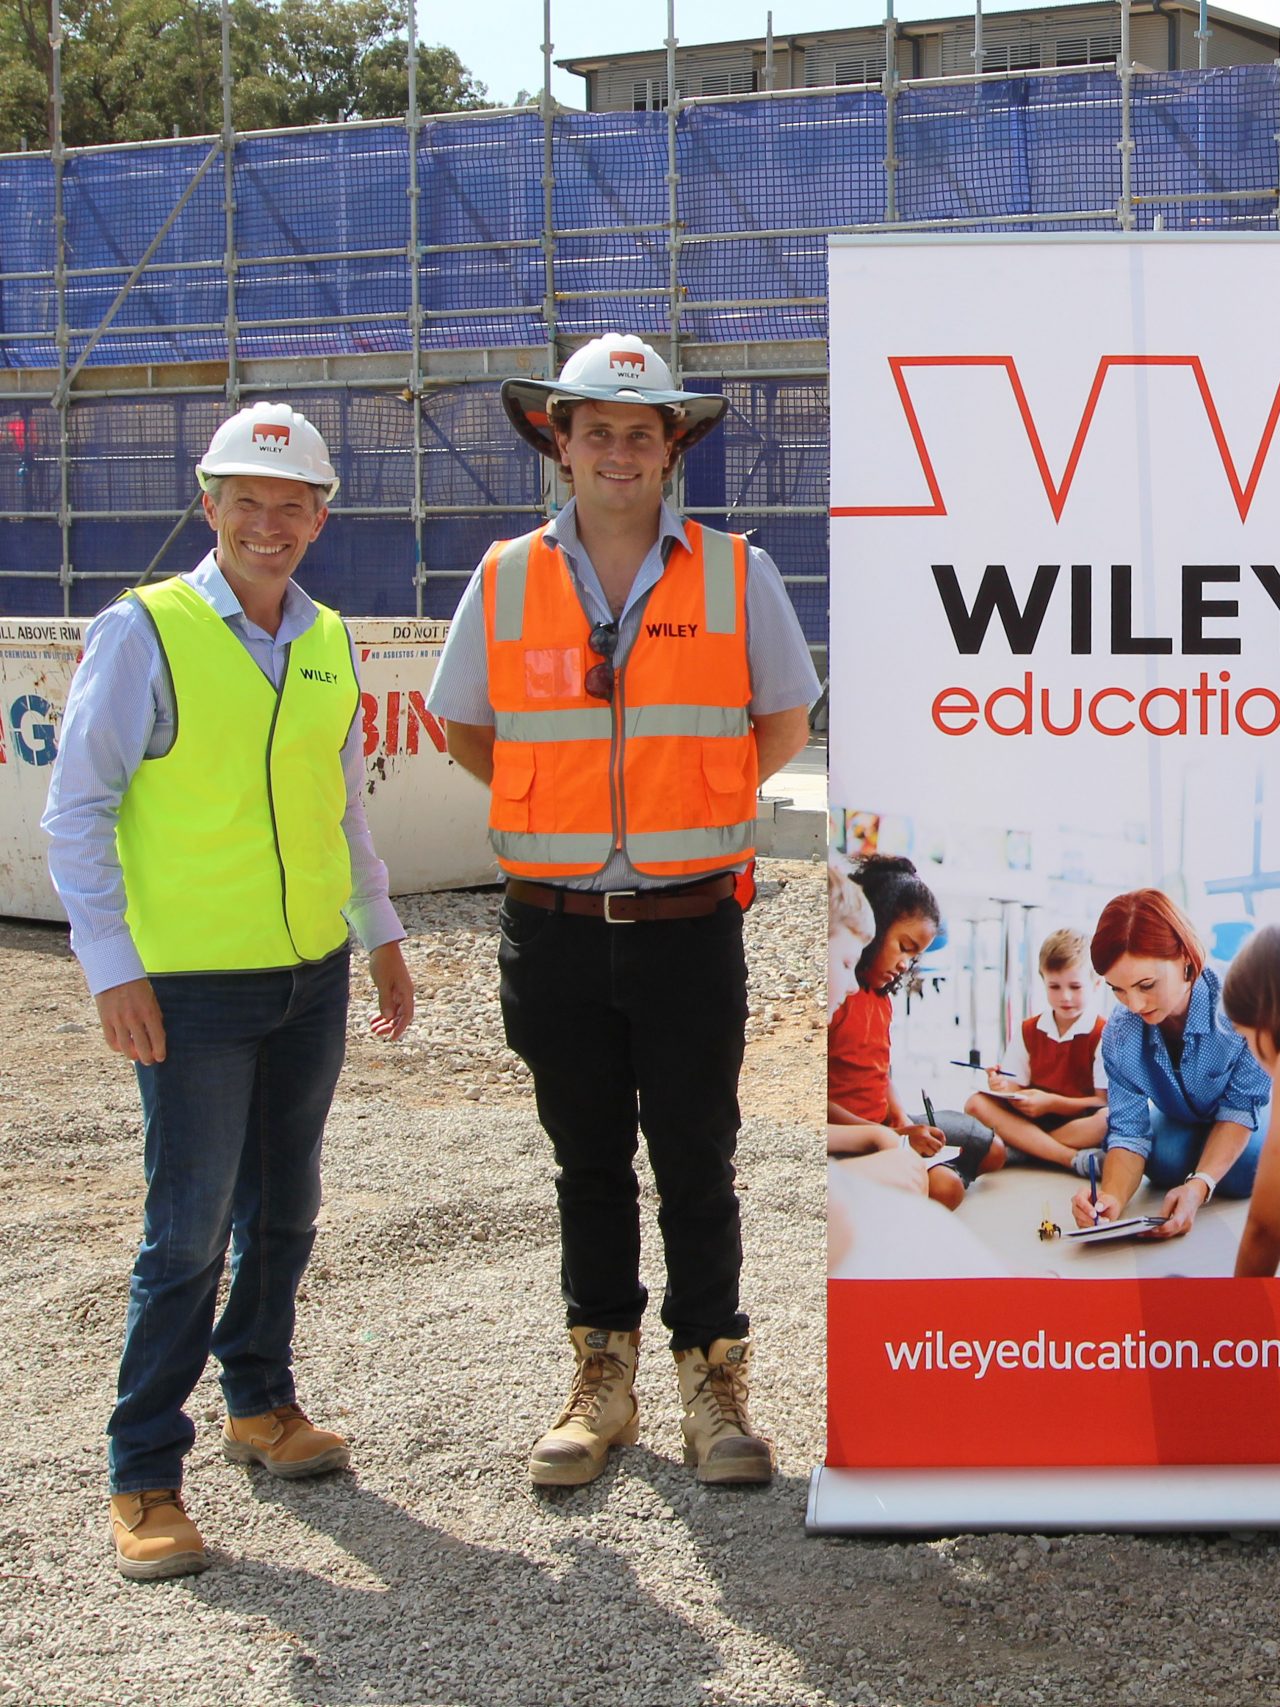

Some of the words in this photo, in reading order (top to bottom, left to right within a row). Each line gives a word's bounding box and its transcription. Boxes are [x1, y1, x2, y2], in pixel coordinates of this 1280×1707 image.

[0, 626, 15, 639] LL
[18, 626, 57, 640] ABOVE
[60, 626, 81, 640] RIM
[393, 626, 411, 639] DO
[414, 626, 440, 639] NOT
[646, 623, 698, 638] WILEY
[4, 650, 37, 659] CHEMICALS
[371, 651, 380, 659] NO
[383, 650, 414, 659] ASBESTOS
[300, 667, 337, 684] WILEY
